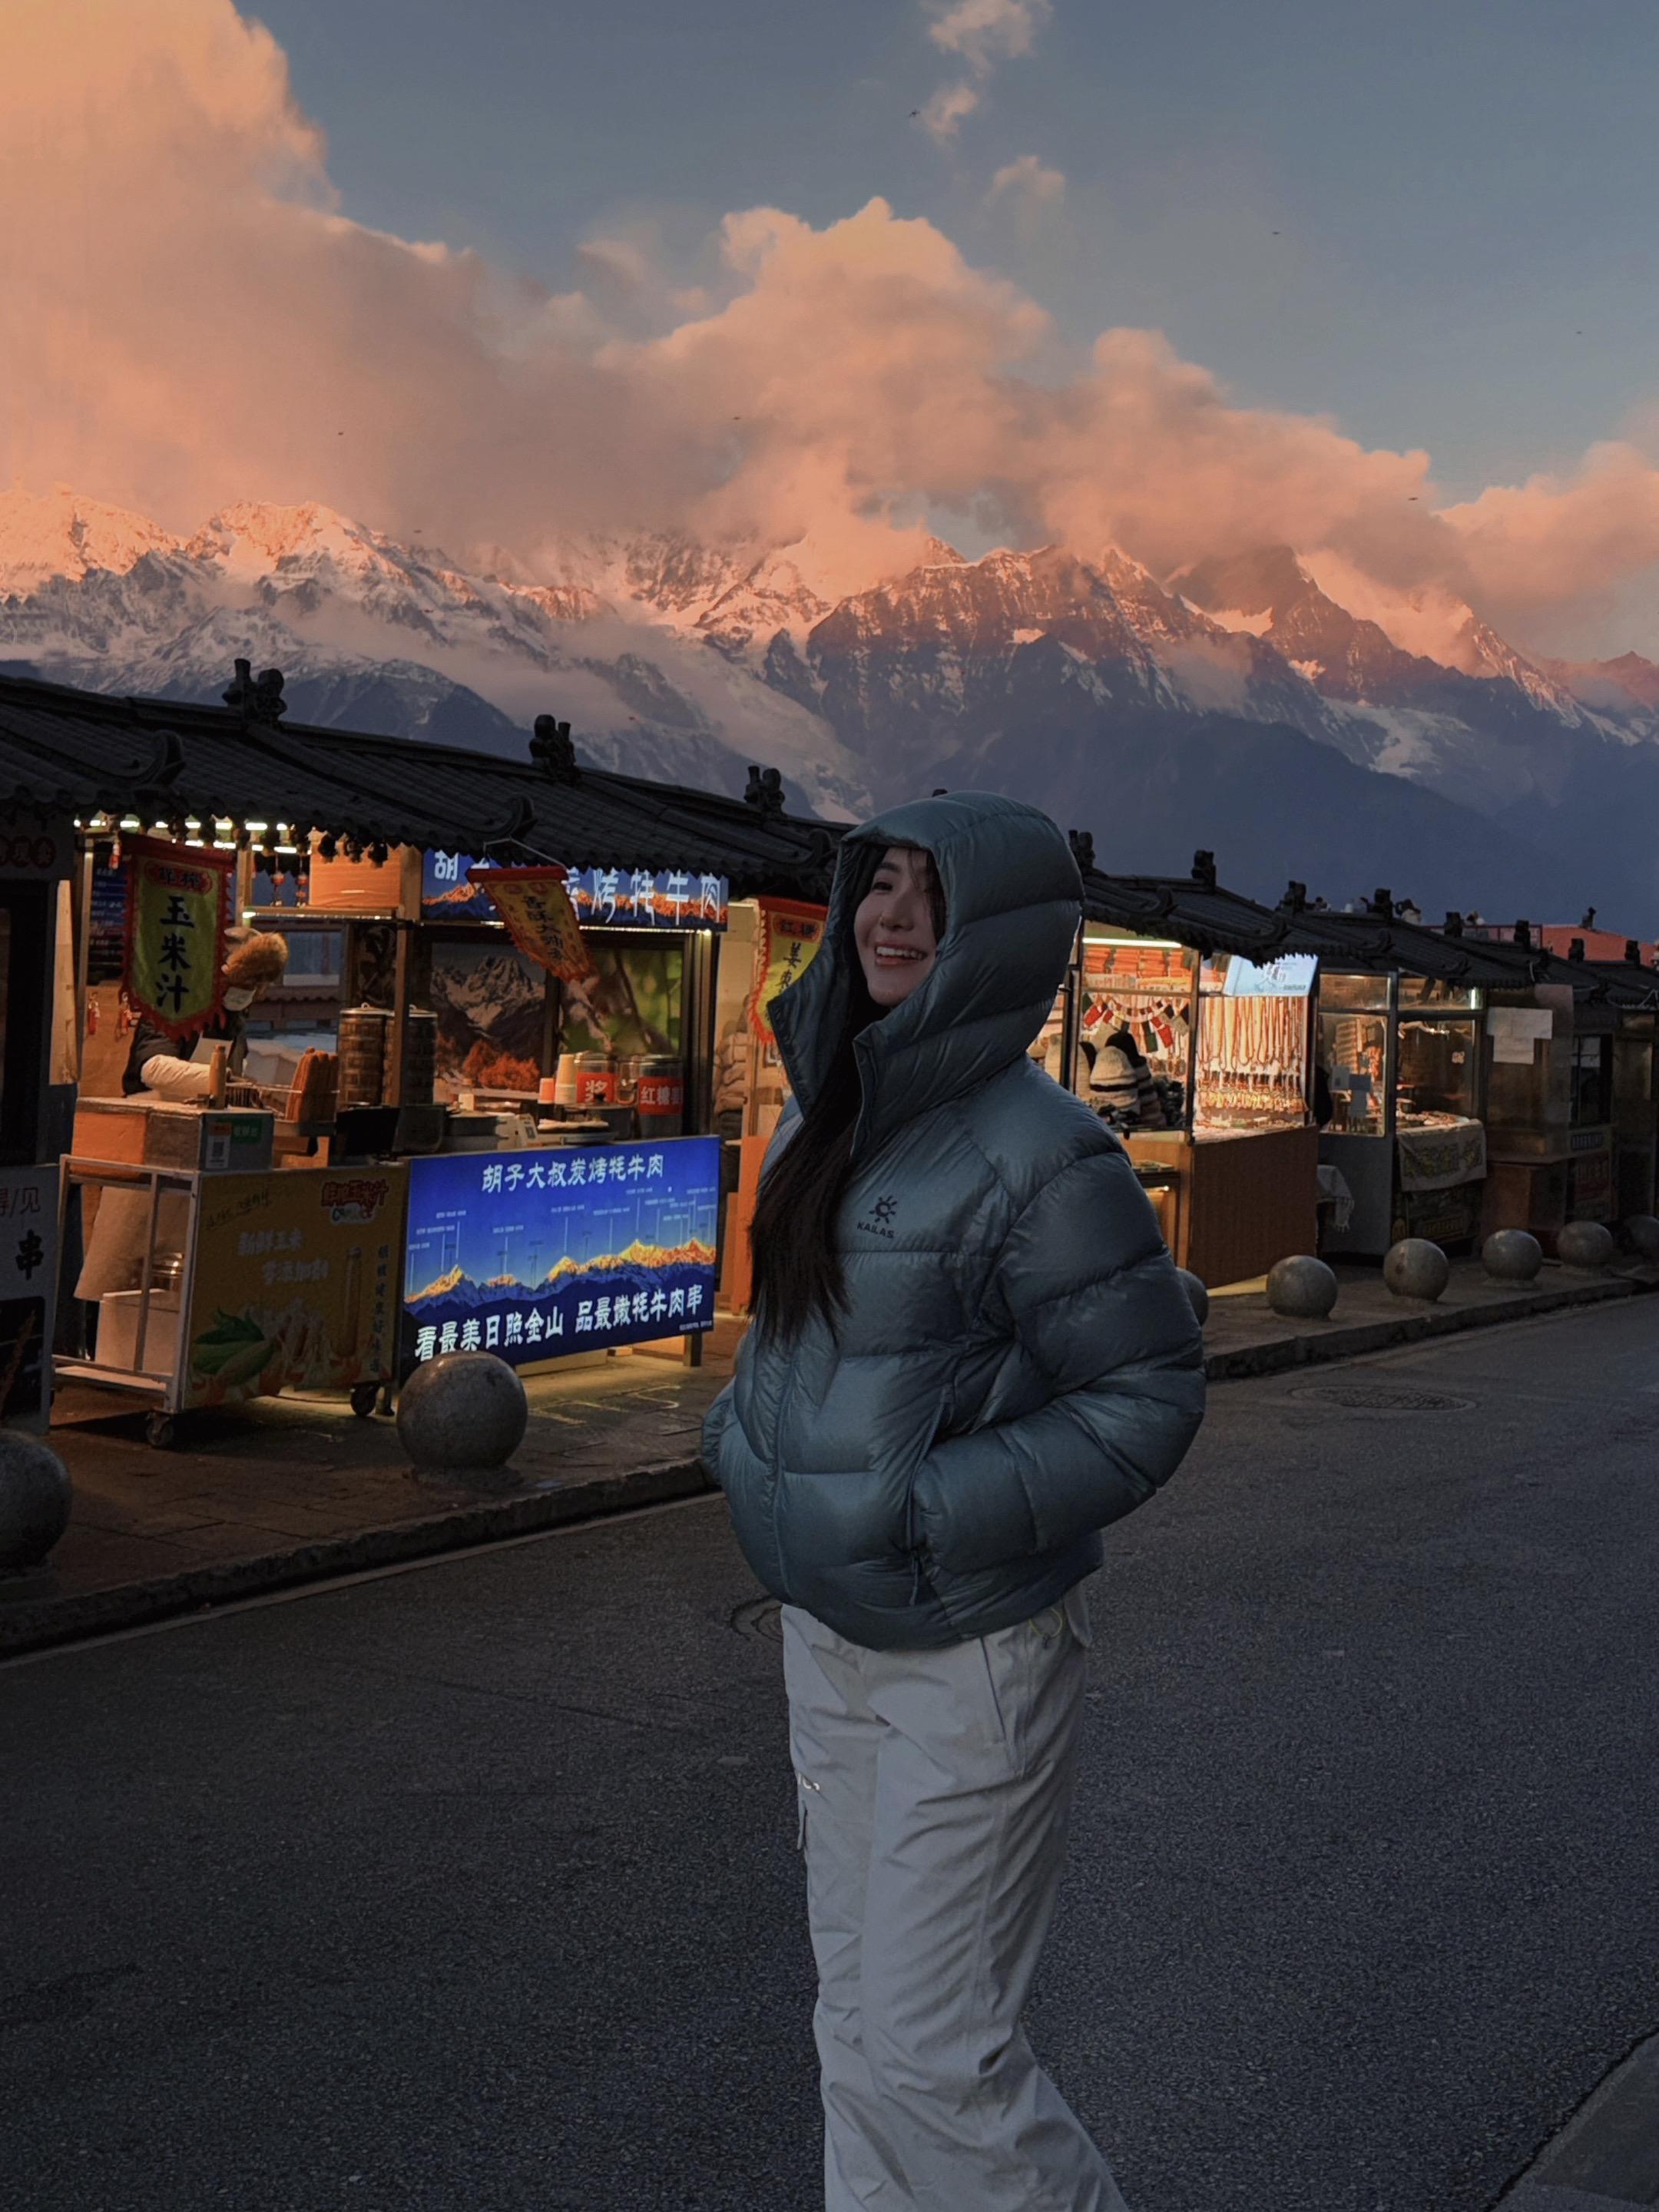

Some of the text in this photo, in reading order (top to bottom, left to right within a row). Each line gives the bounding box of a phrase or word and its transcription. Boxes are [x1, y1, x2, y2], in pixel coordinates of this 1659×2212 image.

[156, 896, 195, 1013] 玉米汁
[482, 1154, 664, 1193] 胡子大叔炭烤牦牛肉
[15, 1229, 44, 1280] 串
[415, 1306, 564, 1362] 看最美日照金山
[575, 1283, 703, 1333] 品最嫩牦牛肉串
